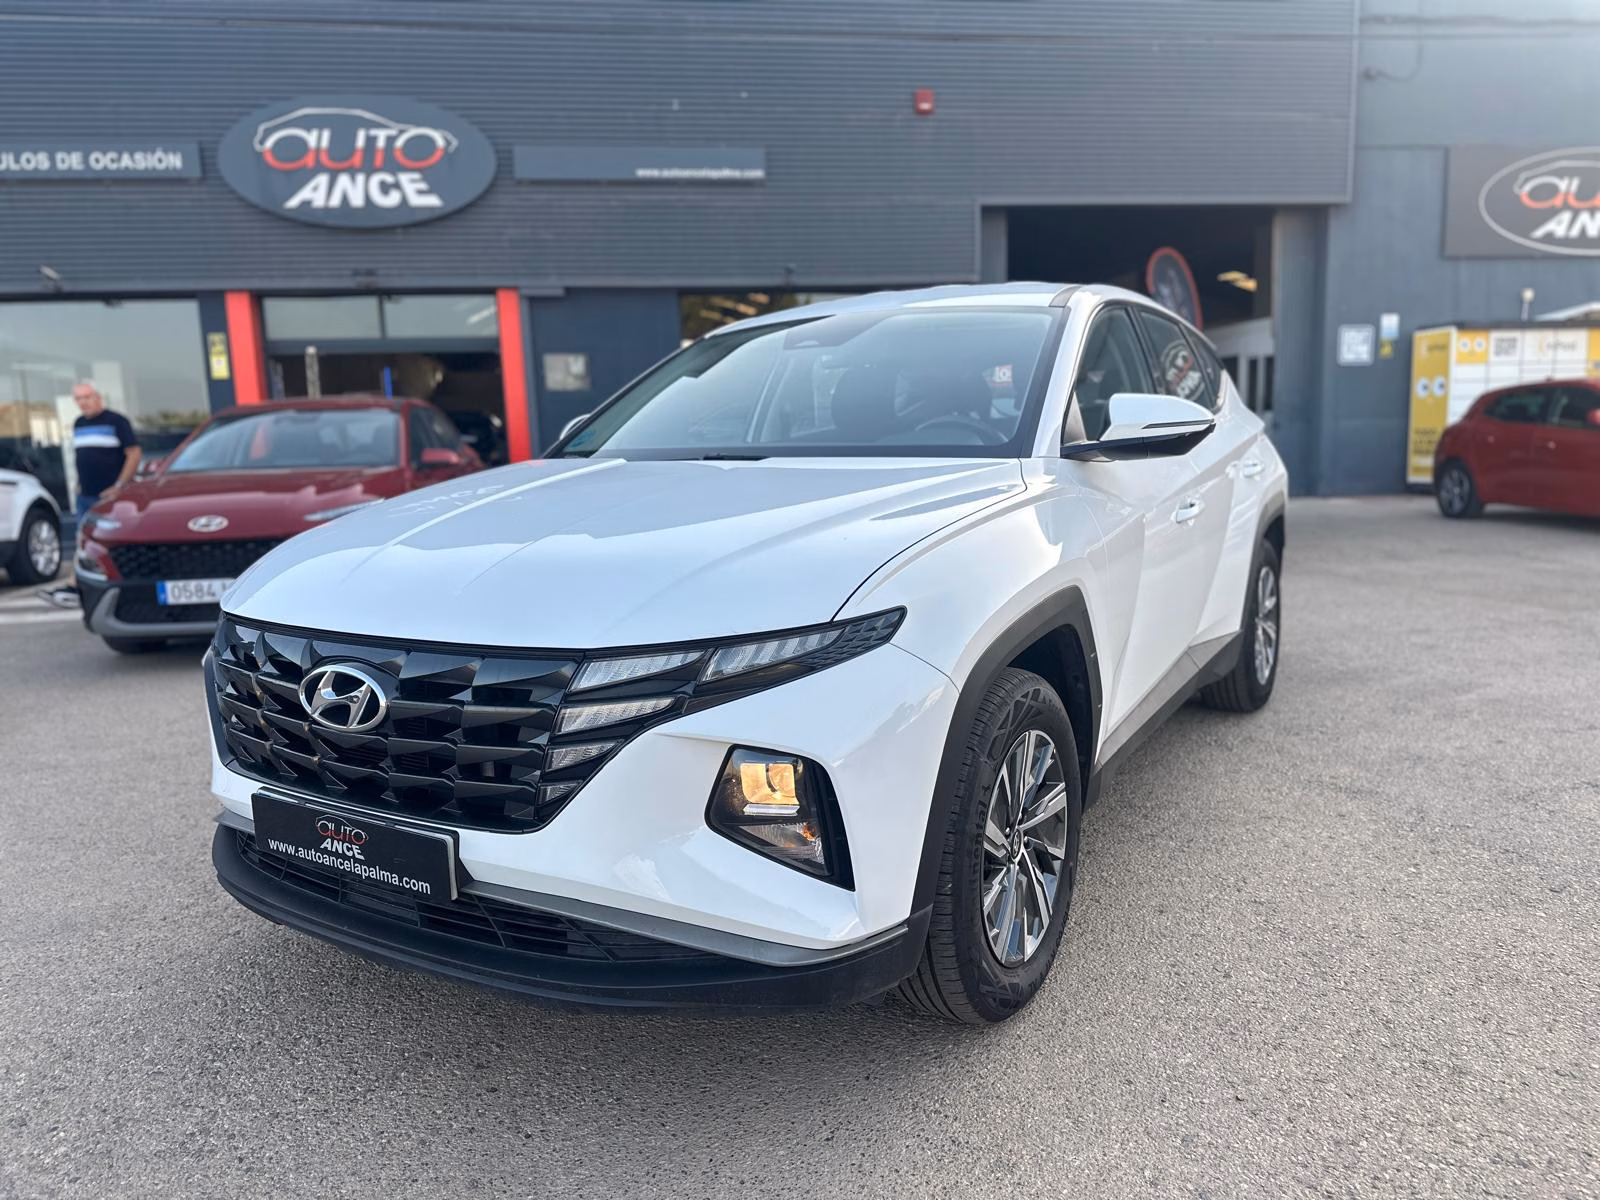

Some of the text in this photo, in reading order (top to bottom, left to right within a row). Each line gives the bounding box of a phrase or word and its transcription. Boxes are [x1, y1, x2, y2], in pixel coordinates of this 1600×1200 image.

[55, 151, 84, 170] DE
[88, 147, 183, 171] OCASIÓN
[283, 172, 444, 208] ANCE
[171, 583, 216, 600] 0584
[320, 838, 365, 860] ANCE
[267, 838, 431, 895] www.autoancelapalma.com
